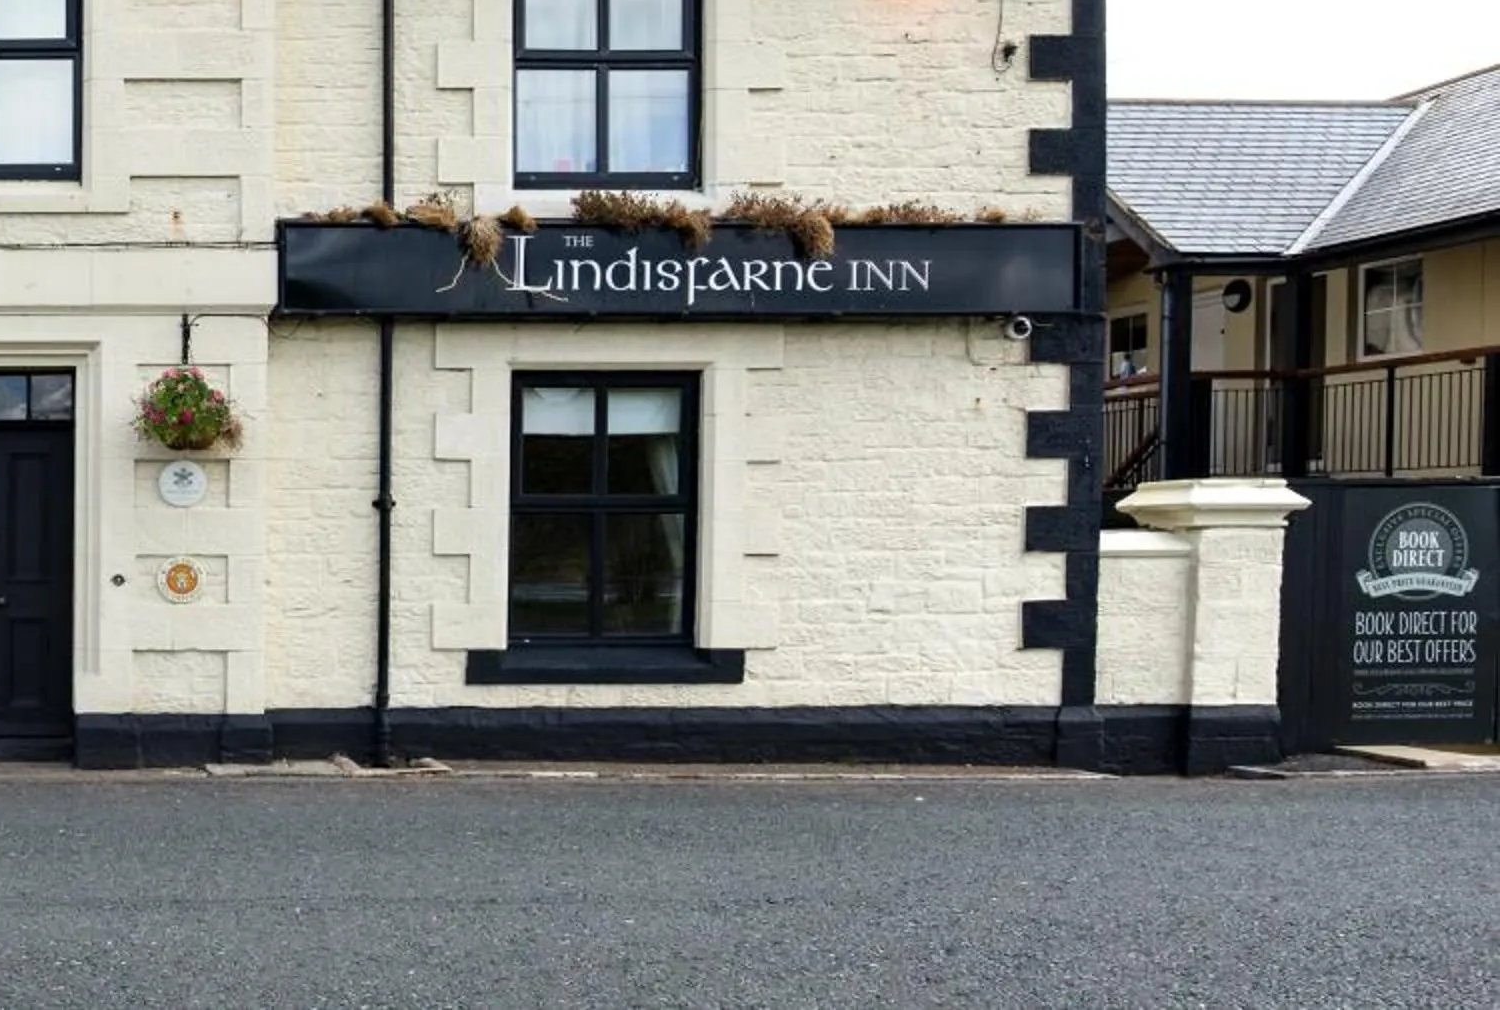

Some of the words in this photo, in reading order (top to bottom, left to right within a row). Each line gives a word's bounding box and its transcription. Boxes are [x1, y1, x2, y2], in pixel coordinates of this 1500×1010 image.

[563, 235, 595, 247] THE
[506, 235, 834, 305] Lindisfarne
[847, 259, 932, 291] INN
[1398, 531, 1440, 549] BOOK
[1392, 549, 1445, 567] DIRECT
[1355, 611, 1395, 635] BOOK
[1399, 611, 1447, 635] DIRECT
[1451, 611, 1477, 635] FOR
[1353, 640, 1383, 663] OUR
[1387, 639, 1422, 663] BEST
[1425, 639, 1476, 663] OFFERS
